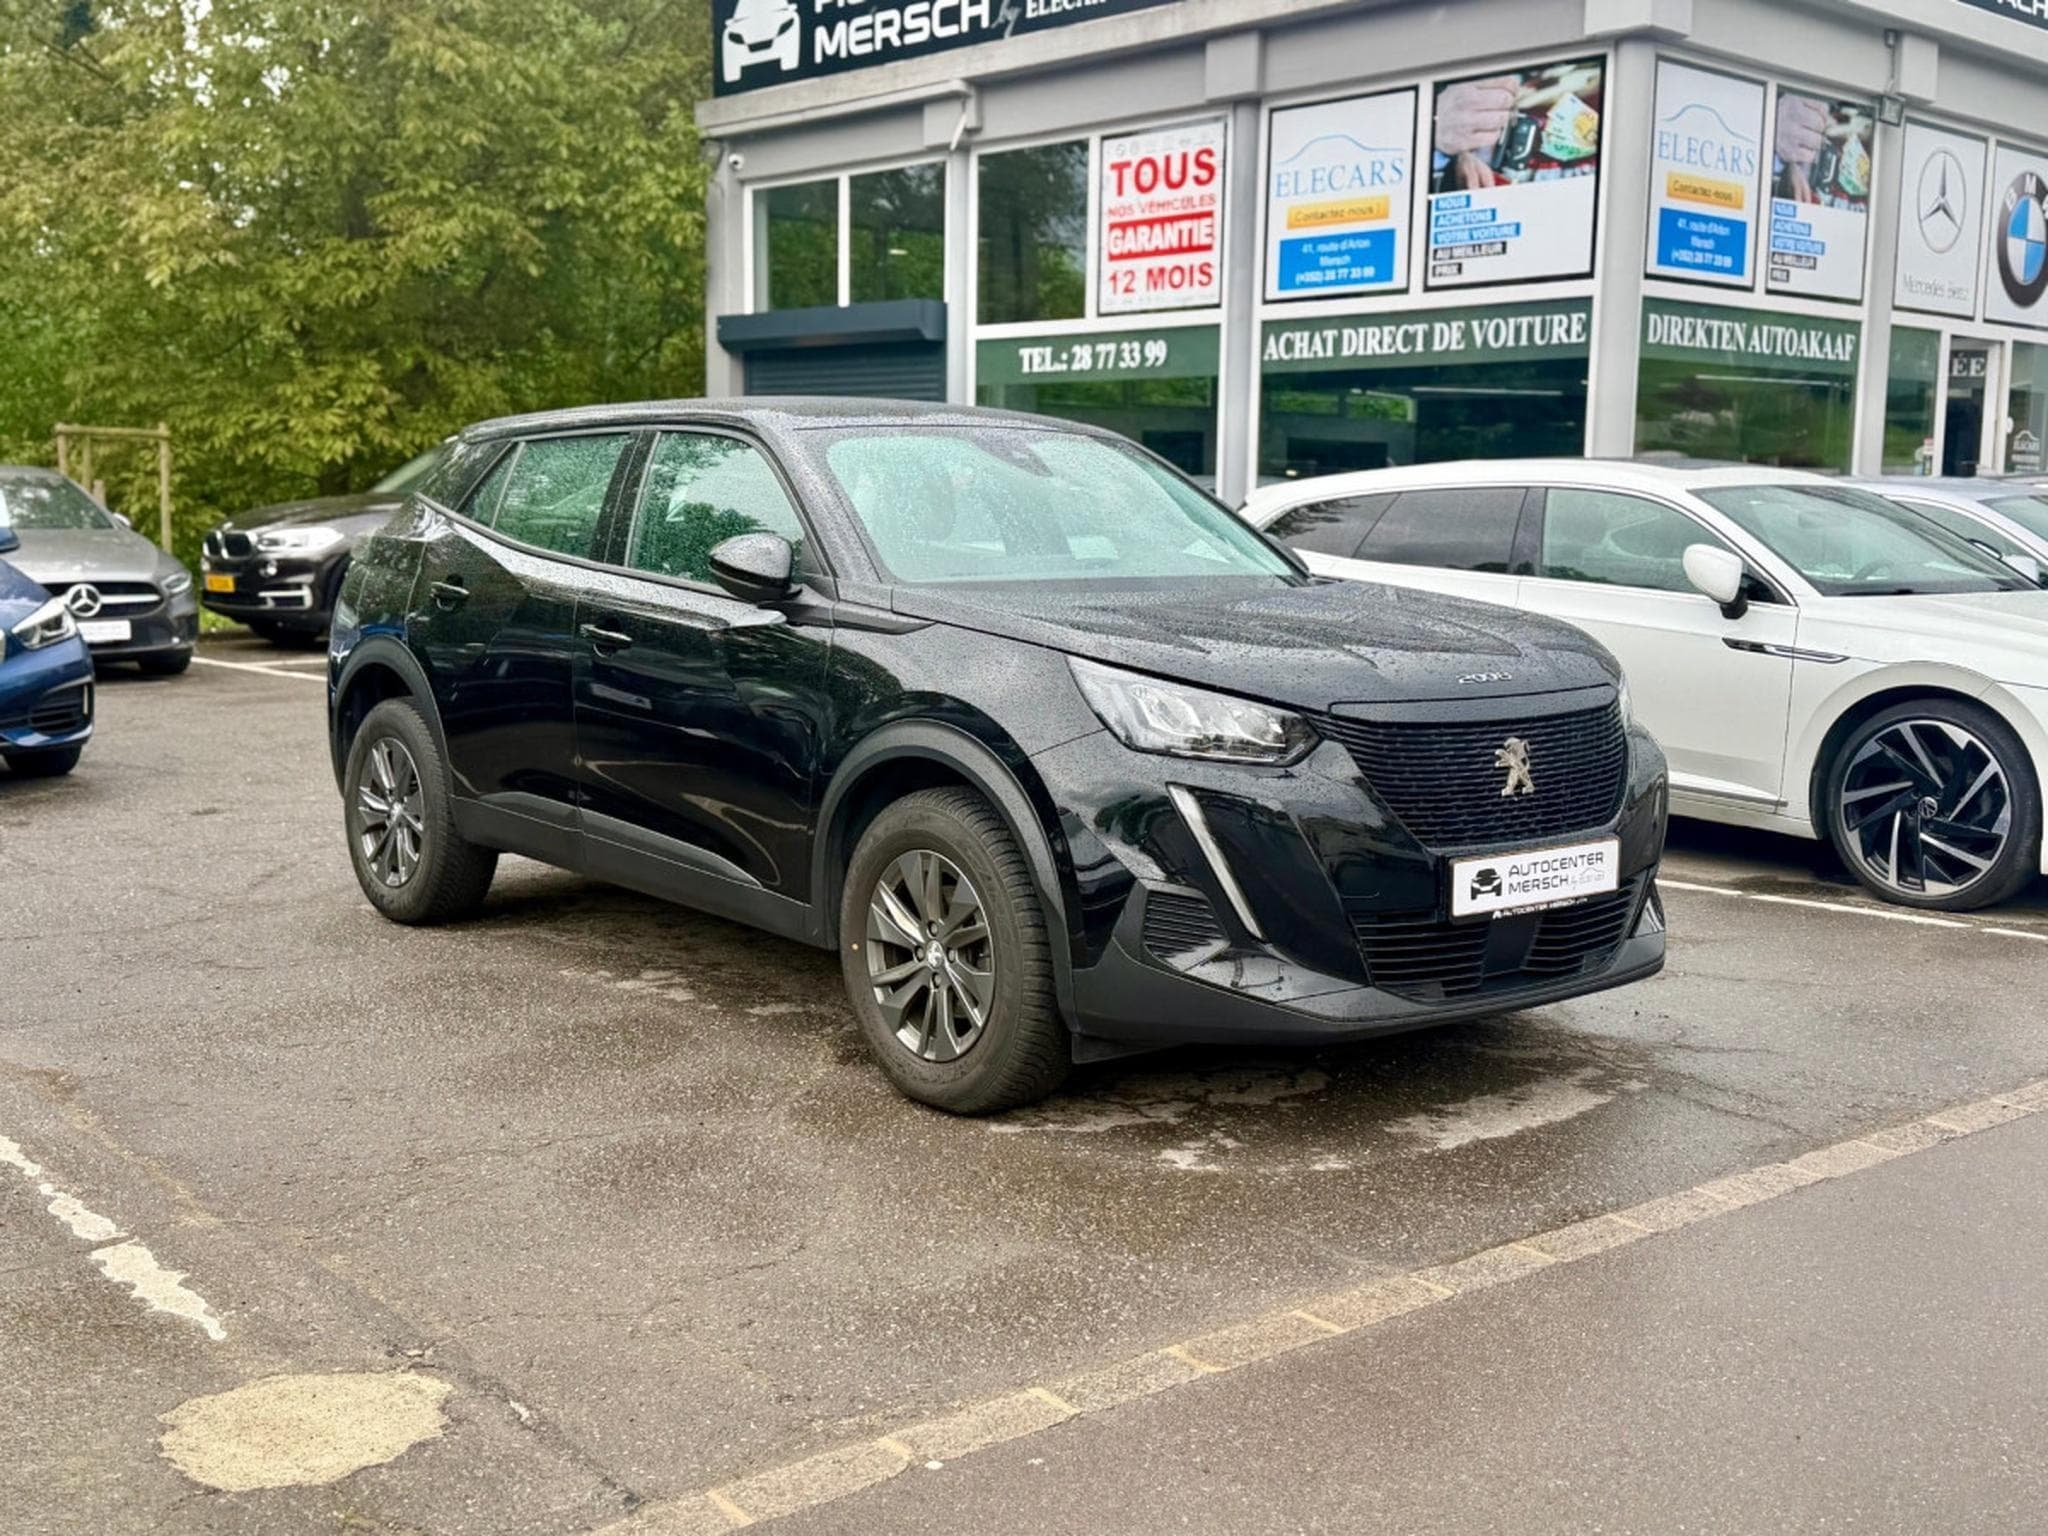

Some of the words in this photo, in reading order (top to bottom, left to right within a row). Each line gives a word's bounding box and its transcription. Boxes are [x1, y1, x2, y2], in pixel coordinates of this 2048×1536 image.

[814, 0, 990, 64] MERSCH
[1110, 147, 1216, 197] TOUS
[1658, 131, 1755, 176] ELECARS
[1276, 158, 1404, 198] ELECARS
[1110, 217, 1214, 255] GARANTIE
[1109, 269, 1135, 294] 12
[1146, 262, 1213, 291] MOIS
[1071, 344, 1092, 371] 28
[1095, 342, 1117, 370] 77
[1119, 341, 1141, 369] 33
[1144, 339, 1167, 367] 99
[1263, 330, 1338, 361] ACHAT
[1341, 323, 1429, 357] DIRECT
[1433, 321, 1465, 351] DE
[1471, 312, 1587, 349] VOITURE
[1647, 313, 1747, 352] DIREKTEN
[1749, 324, 1856, 362] AUTOAKAAF
[1508, 851, 1604, 878] AUTOCENTER
[1508, 874, 1569, 895] MERSCH
